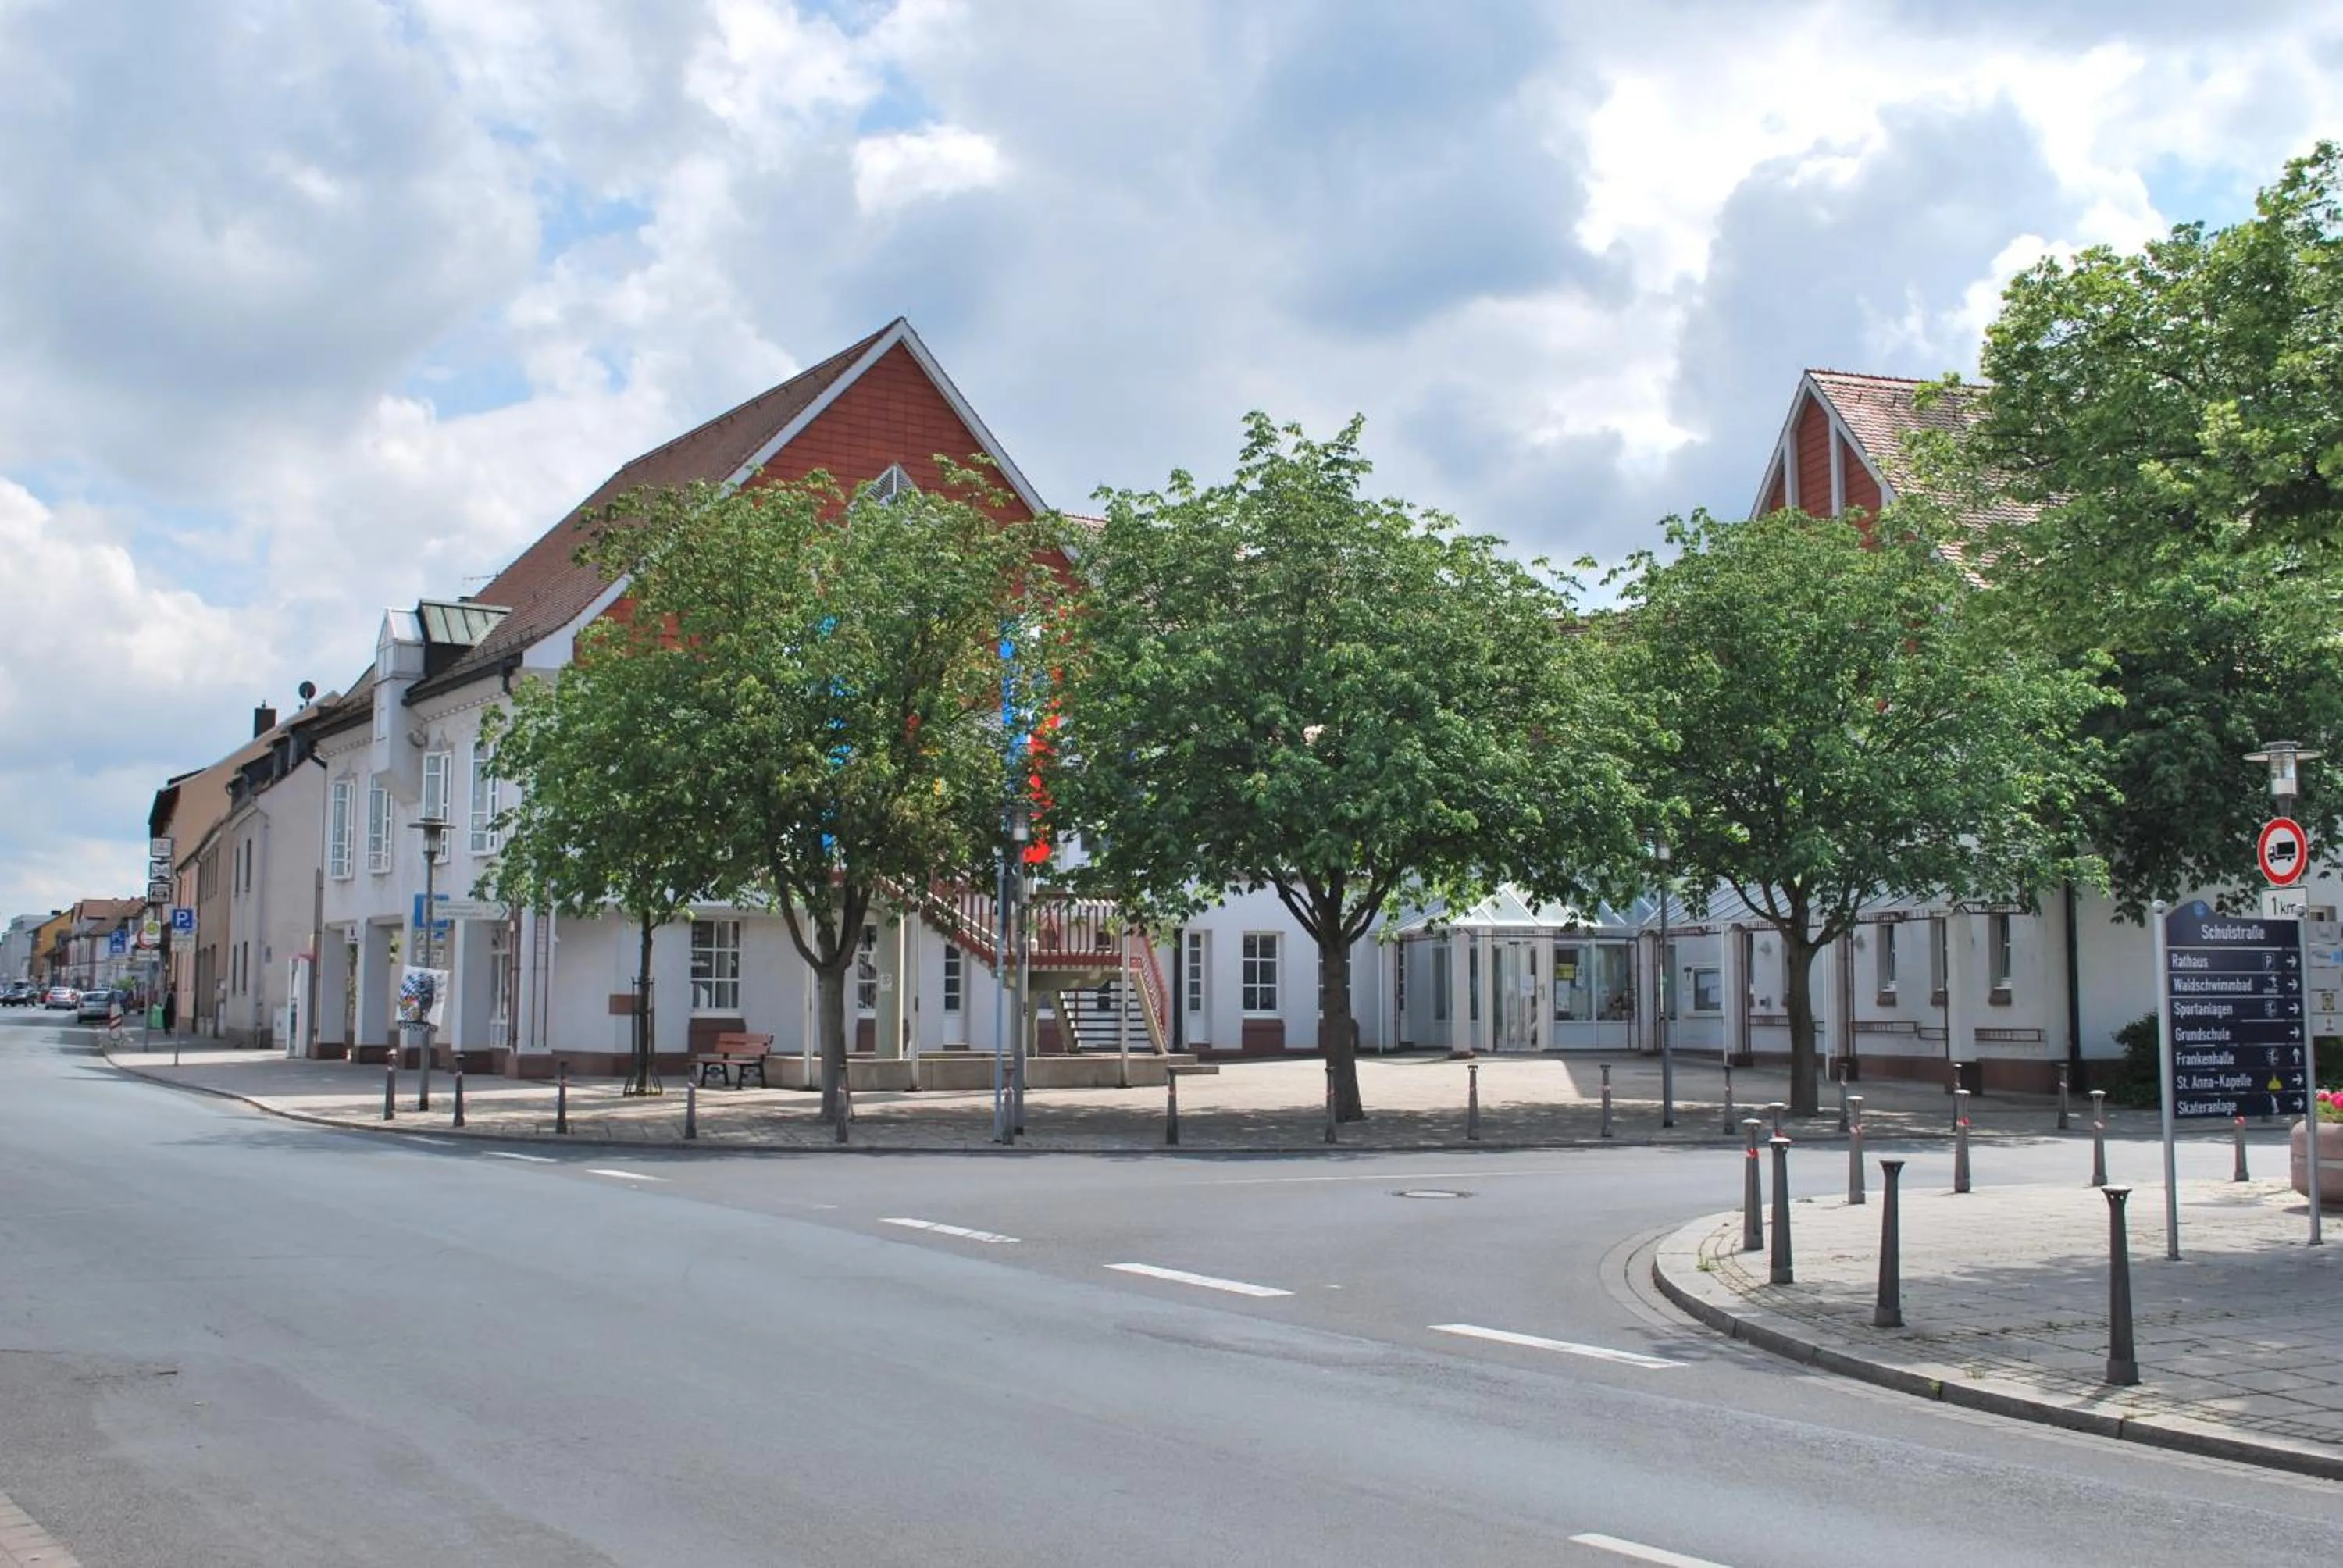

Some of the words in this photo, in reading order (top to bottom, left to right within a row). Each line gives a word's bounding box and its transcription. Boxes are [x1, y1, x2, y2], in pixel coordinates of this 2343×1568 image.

[2271, 896, 2277, 916] 1
[176, 911, 188, 927] P
[2201, 924, 2265, 939] Schulstraße
[2171, 953, 2209, 968] Rathaus
[2266, 955, 2272, 968] P
[2174, 978, 2253, 992] Waldschwimmbad
[2174, 1002, 2233, 1019] Sportanlagen
[2175, 1027, 2231, 1041] Grundschule
[2176, 1051, 2235, 1066] Frankenhalle
[2177, 1075, 2189, 1089] St.
[2191, 1073, 2252, 1091] Anna-Kapelle
[2178, 1099, 2238, 1116] Skateranlage
